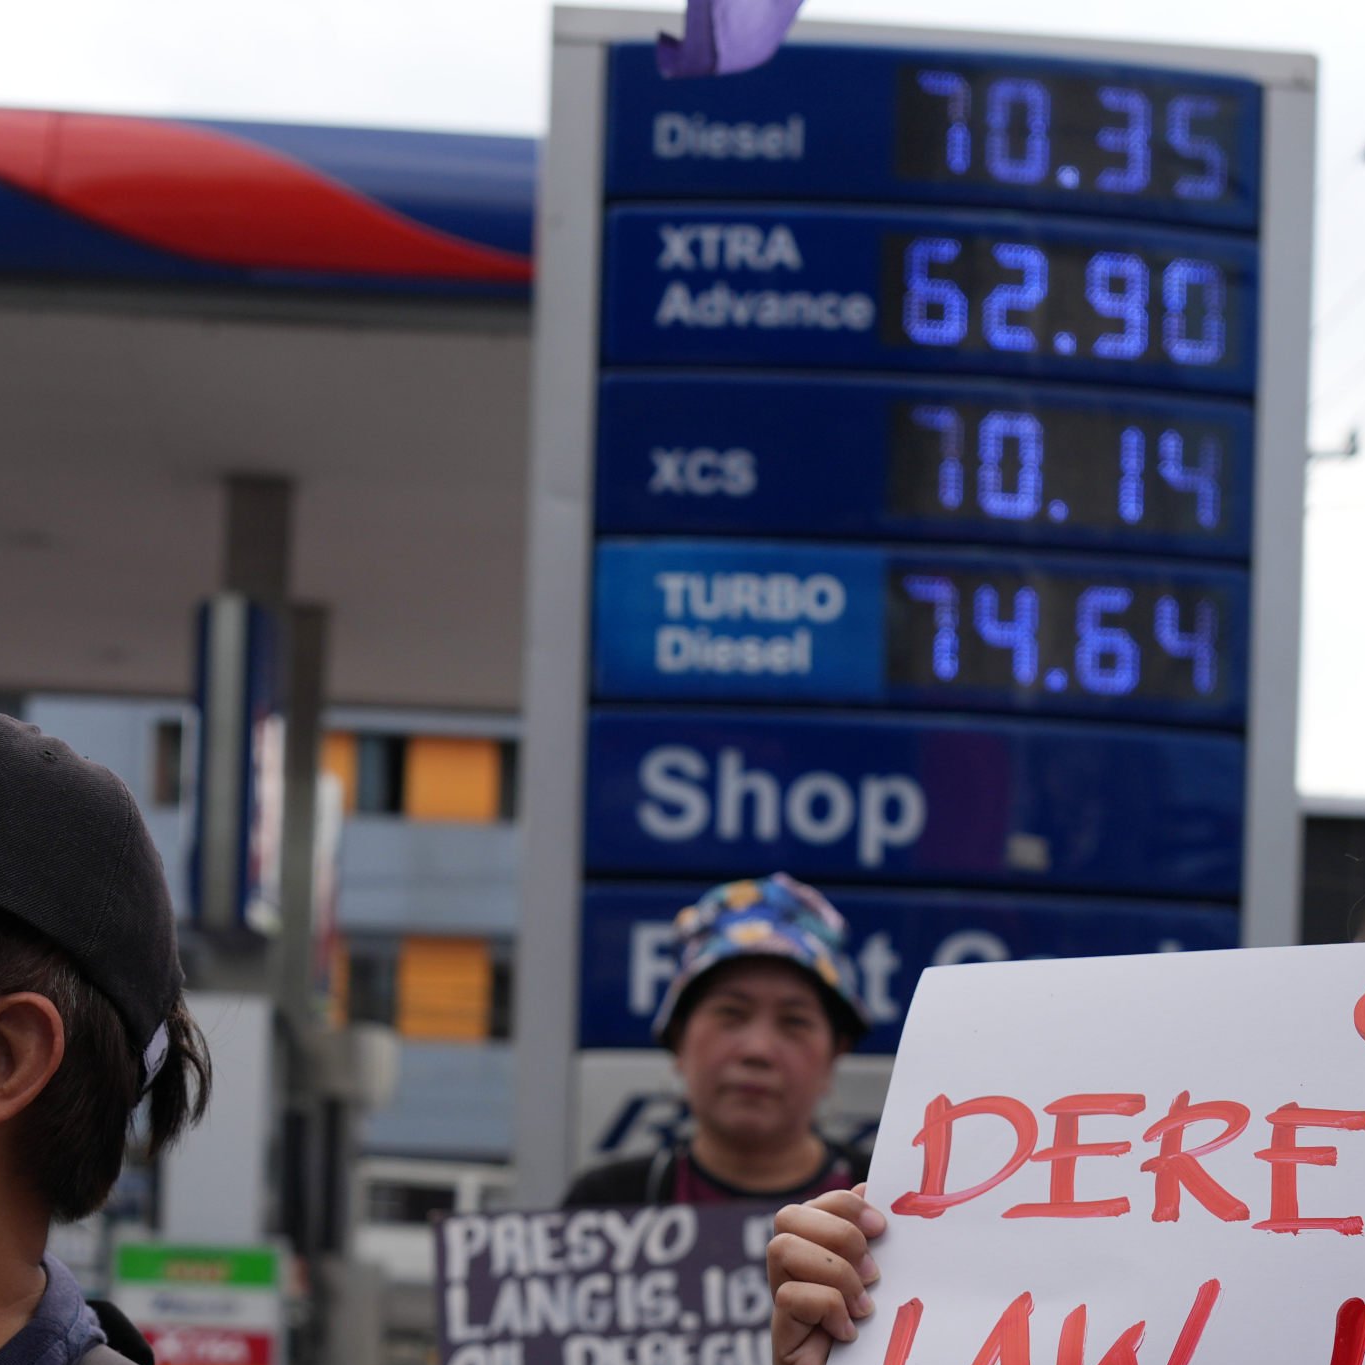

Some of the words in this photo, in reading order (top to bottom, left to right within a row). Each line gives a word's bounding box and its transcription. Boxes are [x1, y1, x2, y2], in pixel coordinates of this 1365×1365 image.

[654, 113, 805, 160] Diesel
[914, 69, 1229, 200] 70.35
[657, 225, 803, 271] XTRA
[655, 283, 876, 331] Advance
[903, 237, 1227, 366] 62.90
[648, 450, 758, 496] XCS
[910, 406, 1222, 529] 70.14
[656, 572, 846, 622] TURBO
[656, 627, 813, 676] Diesel
[903, 575, 1220, 696] 74.64
[637, 744, 927, 868] Shop
[443, 1206, 698, 1280] PRESYO
